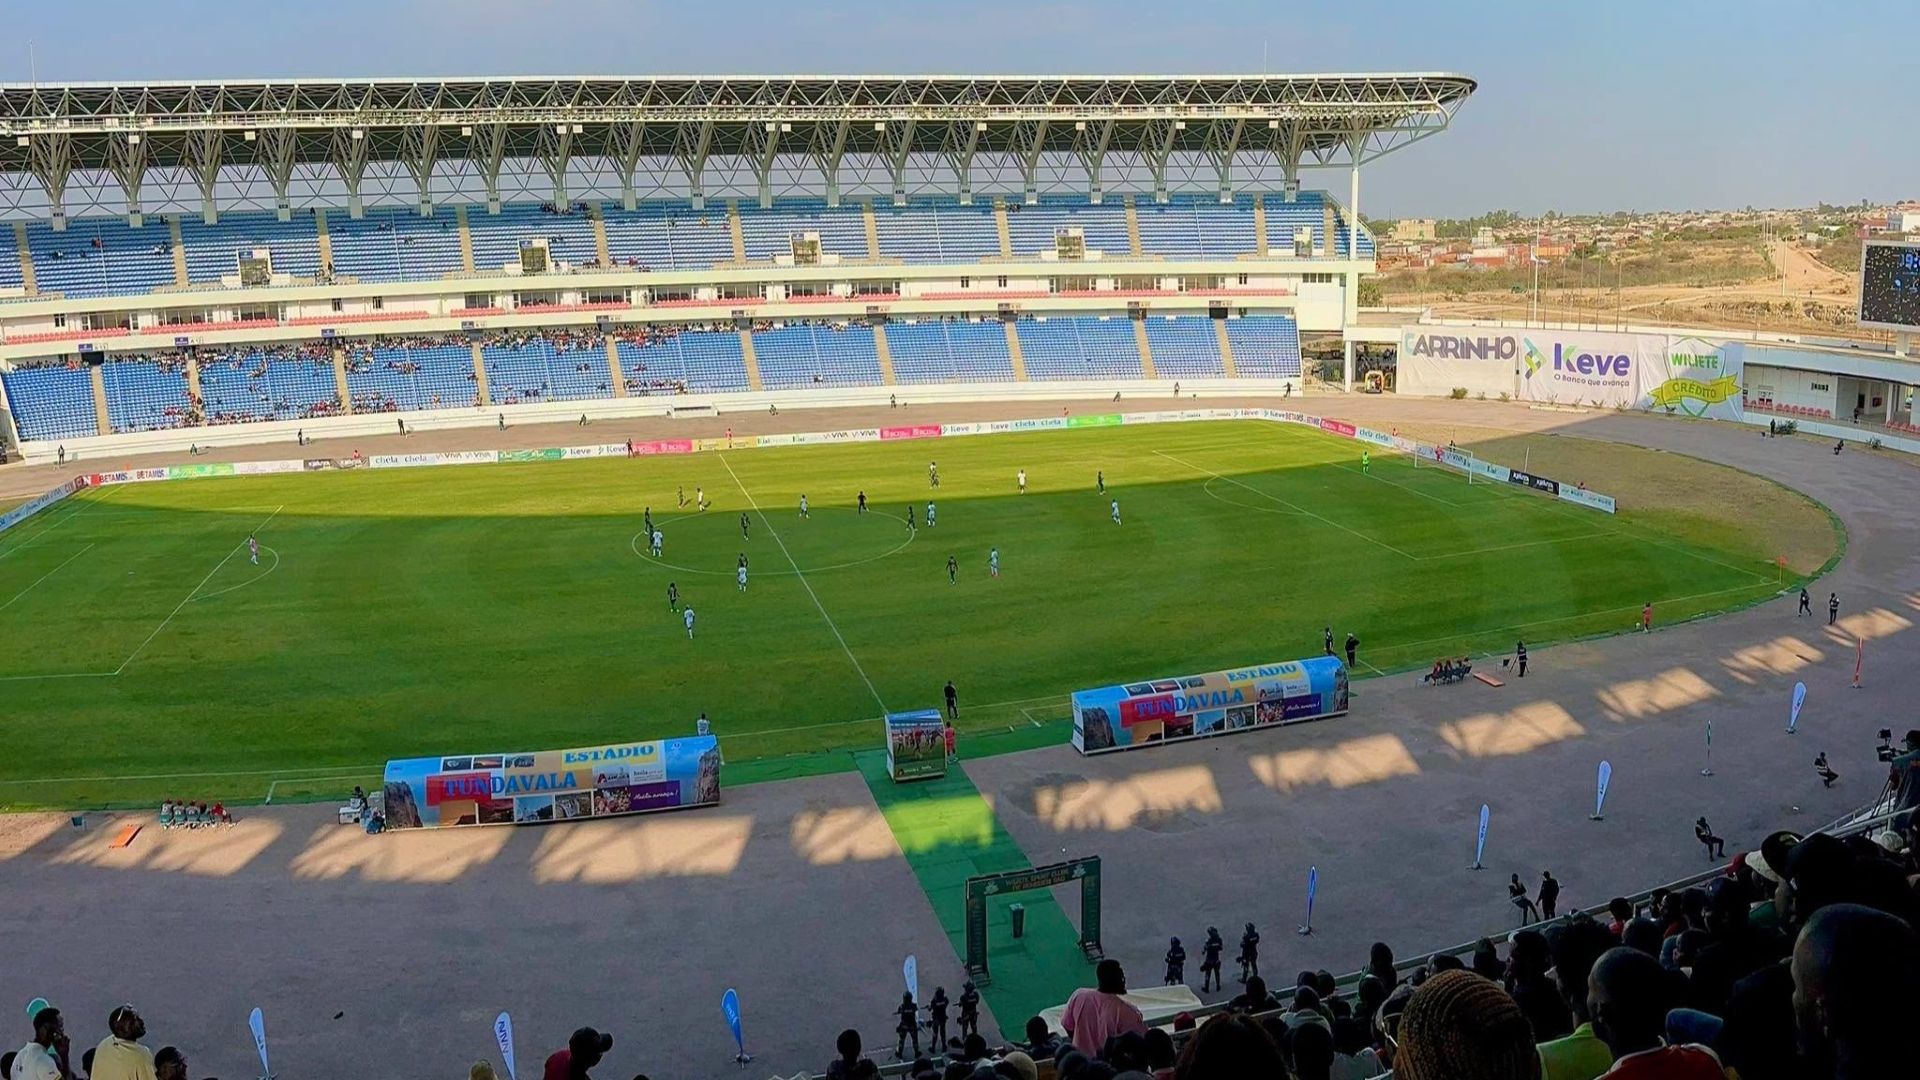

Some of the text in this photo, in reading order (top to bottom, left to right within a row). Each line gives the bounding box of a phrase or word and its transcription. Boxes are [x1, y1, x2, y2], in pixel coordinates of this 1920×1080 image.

[1404, 332, 1516, 360] CARRINHO
[1554, 343, 1631, 377] Keve
[1562, 374, 1586, 384] Banco
[1587, 379, 1600, 387] que
[1602, 379, 1630, 388] avança
[1672, 381, 1717, 399] CRÉDITO
[1135, 688, 1245, 716] TUNDAVALA
[443, 771, 578, 797] TUNDAVALA
